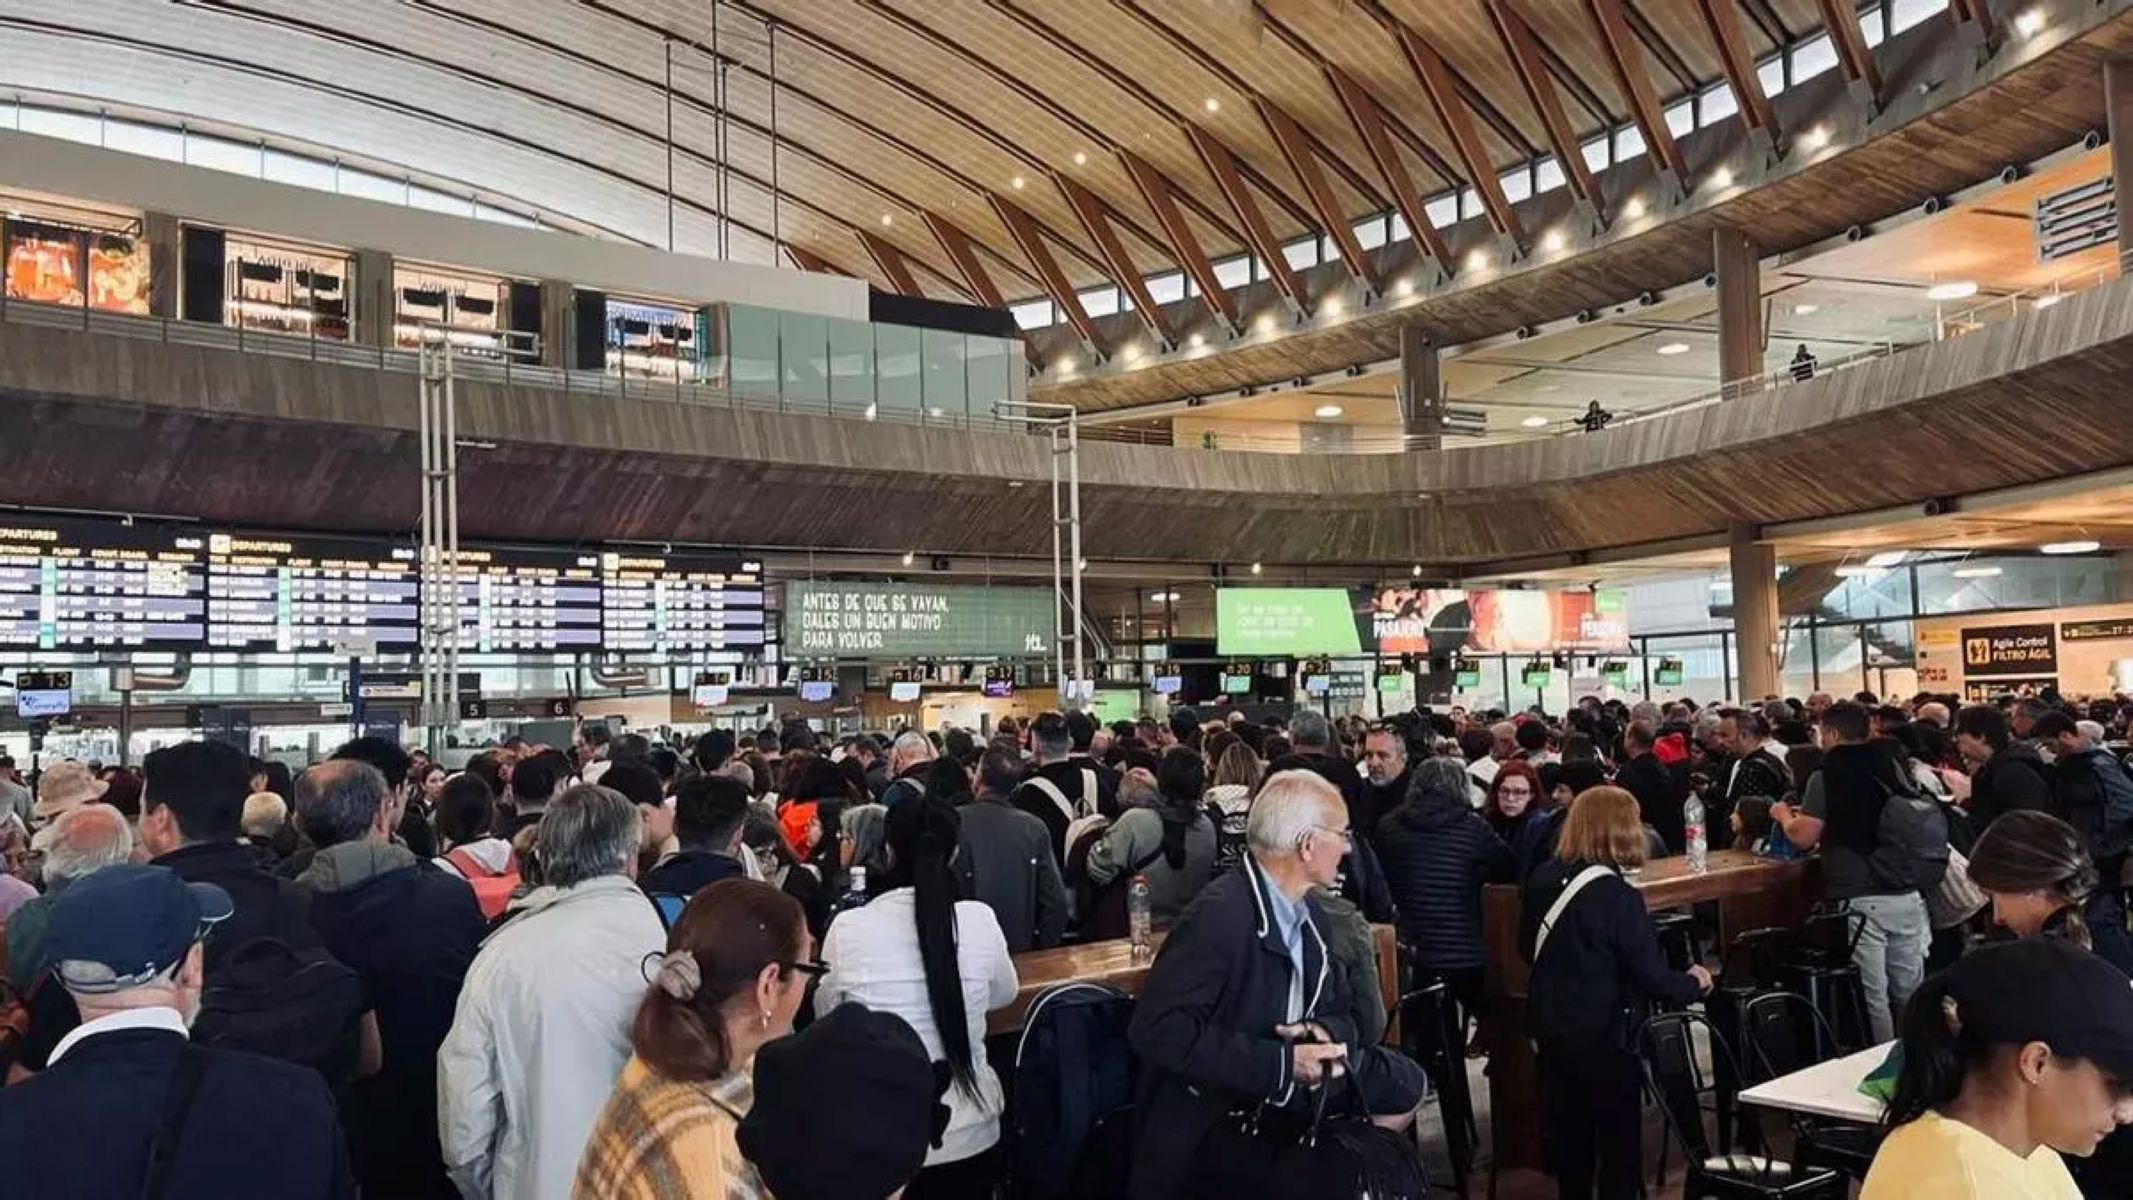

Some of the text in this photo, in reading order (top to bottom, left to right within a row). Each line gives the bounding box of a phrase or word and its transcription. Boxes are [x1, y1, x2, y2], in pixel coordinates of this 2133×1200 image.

[802, 592, 839, 610] ANTES
[845, 593, 860, 611] DE
[865, 594, 887, 611] QUE
[802, 612, 942, 631] DALES UN BUEN MOTIVO
[802, 631, 834, 648] PARA
[1993, 636, 2048, 650] Agile Control
[1993, 649, 2027, 662] FILTRO
[1237, 664, 1251, 675] 20
[48, 673, 70, 688] 13
[469, 703, 479, 717] 5
[554, 702, 563, 715] 6
